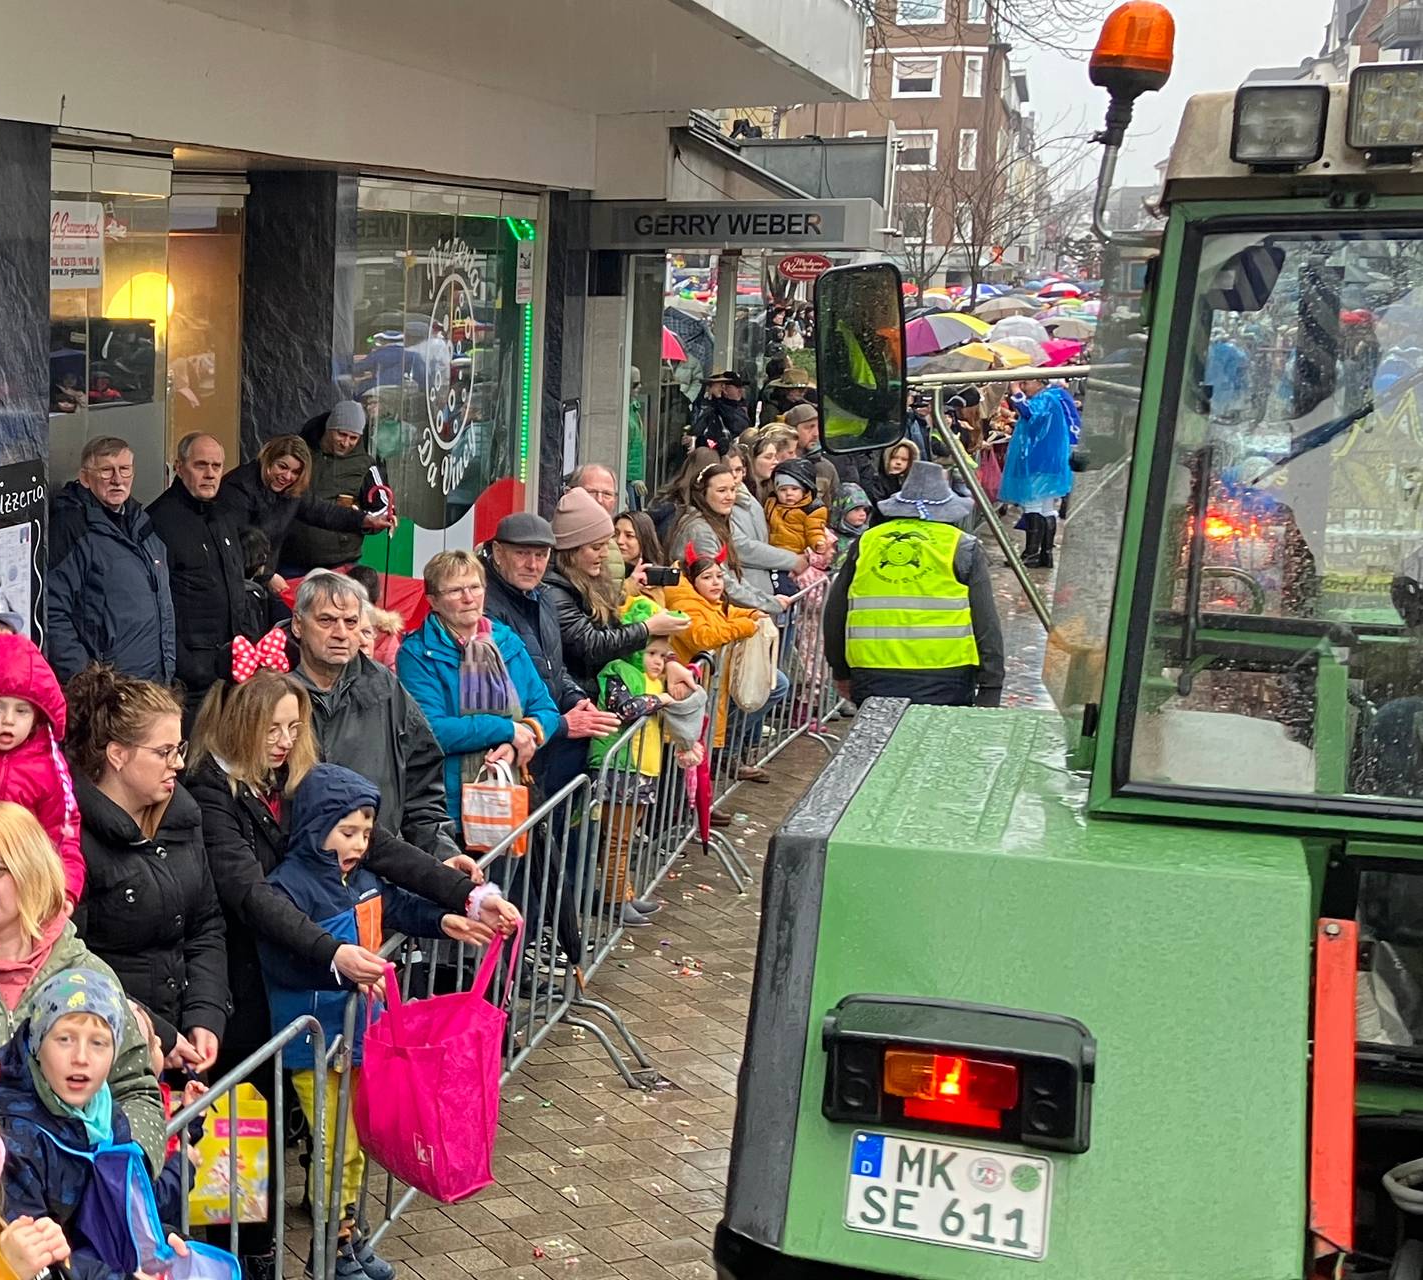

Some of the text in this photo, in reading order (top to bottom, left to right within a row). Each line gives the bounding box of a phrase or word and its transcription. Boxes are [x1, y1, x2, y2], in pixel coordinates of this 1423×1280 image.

[634, 213, 822, 236] GERRY WEBER
[860, 1160, 872, 1174] D
[896, 1144, 958, 1191] MK
[859, 1185, 1028, 1250] SE 611
